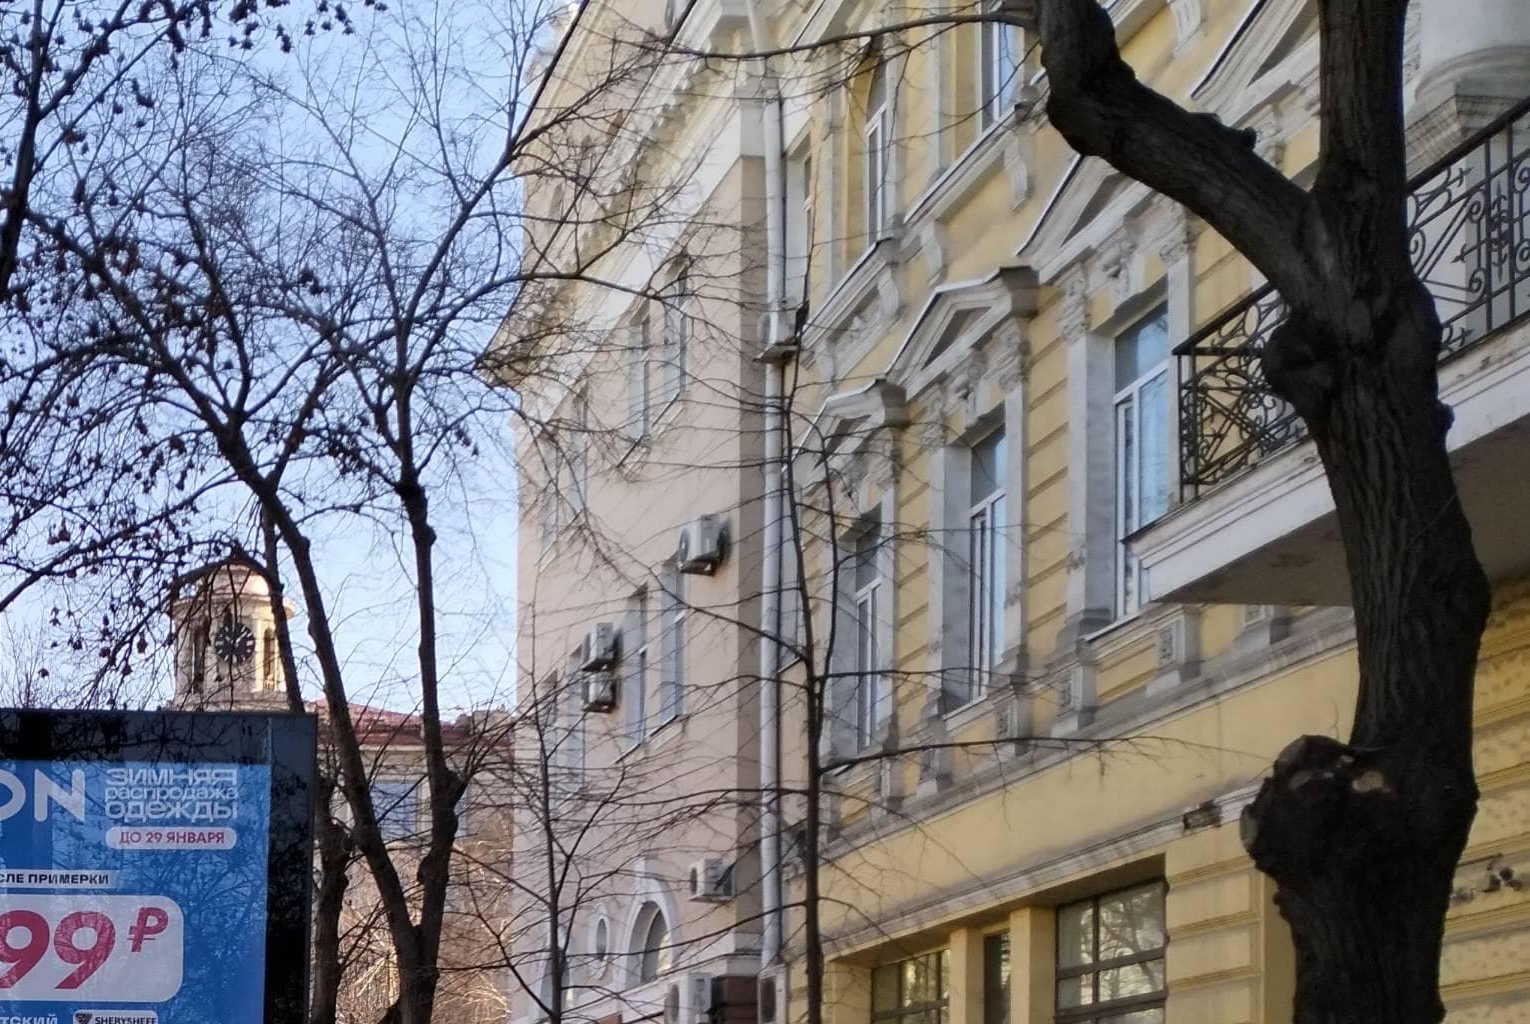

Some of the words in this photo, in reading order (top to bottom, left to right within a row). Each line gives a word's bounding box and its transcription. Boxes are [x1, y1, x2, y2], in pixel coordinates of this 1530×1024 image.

[105, 768, 238, 786] ЗИМНЯЯ
[104, 786, 239, 802] распродажа
[104, 801, 238, 823] одежды
[119, 831, 142, 845] ДО
[145, 832, 163, 843] 29
[166, 831, 225, 844] ЯНВАРЯ
[28, 873, 109, 885] ПРИМЕРКИ
